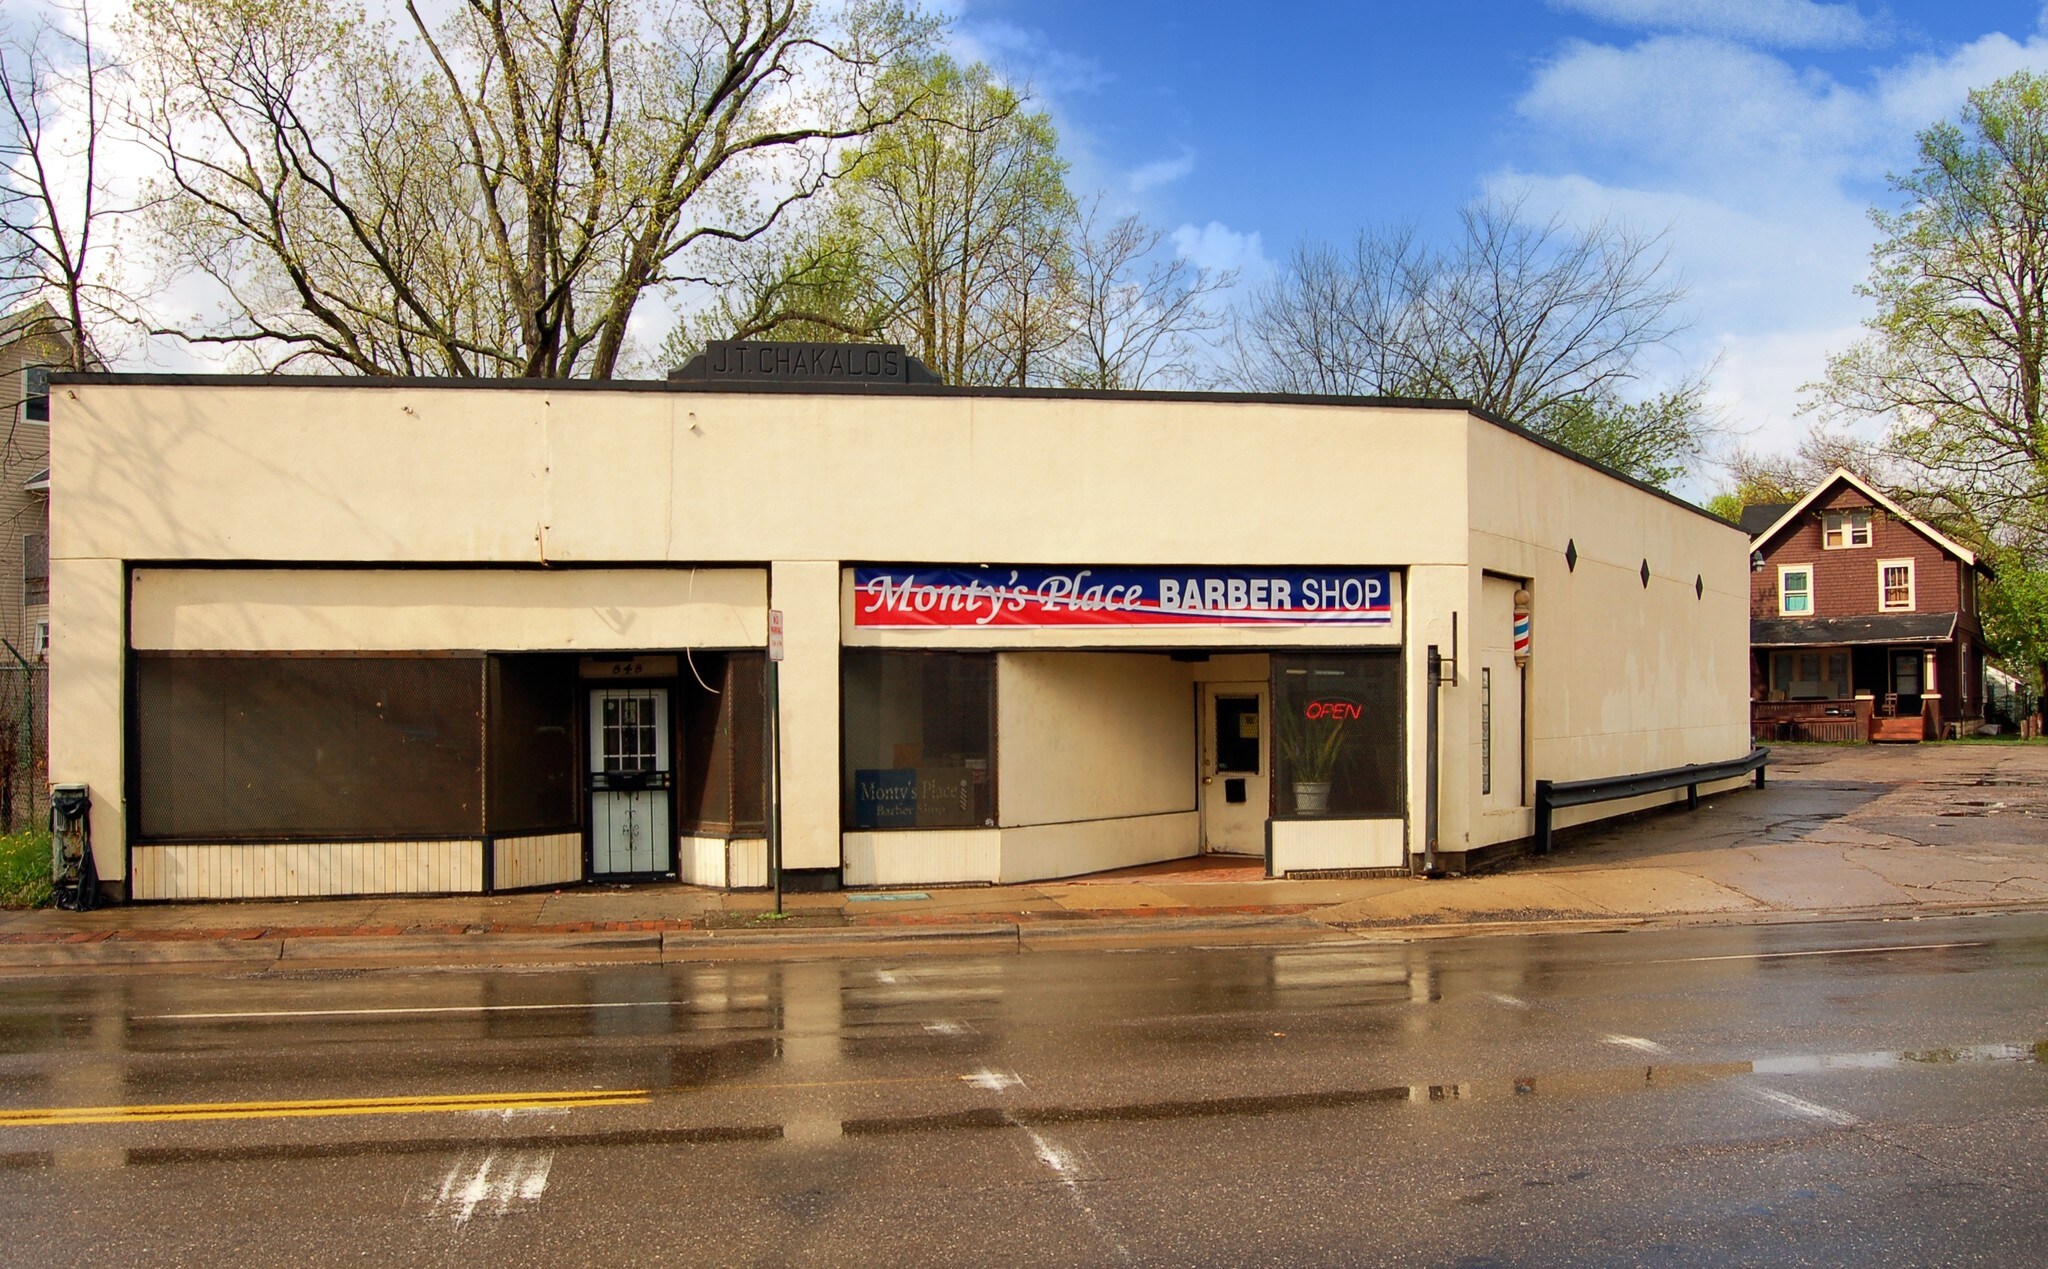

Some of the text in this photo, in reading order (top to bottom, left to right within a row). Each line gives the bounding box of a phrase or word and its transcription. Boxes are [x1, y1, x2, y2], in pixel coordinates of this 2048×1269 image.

[713, 348, 898, 377] J.T. CHAKALOS
[864, 570, 1382, 625] Monty's Place BARBER SHOP
[613, 663, 642, 675] 848
[1306, 702, 1362, 719] OPEN
